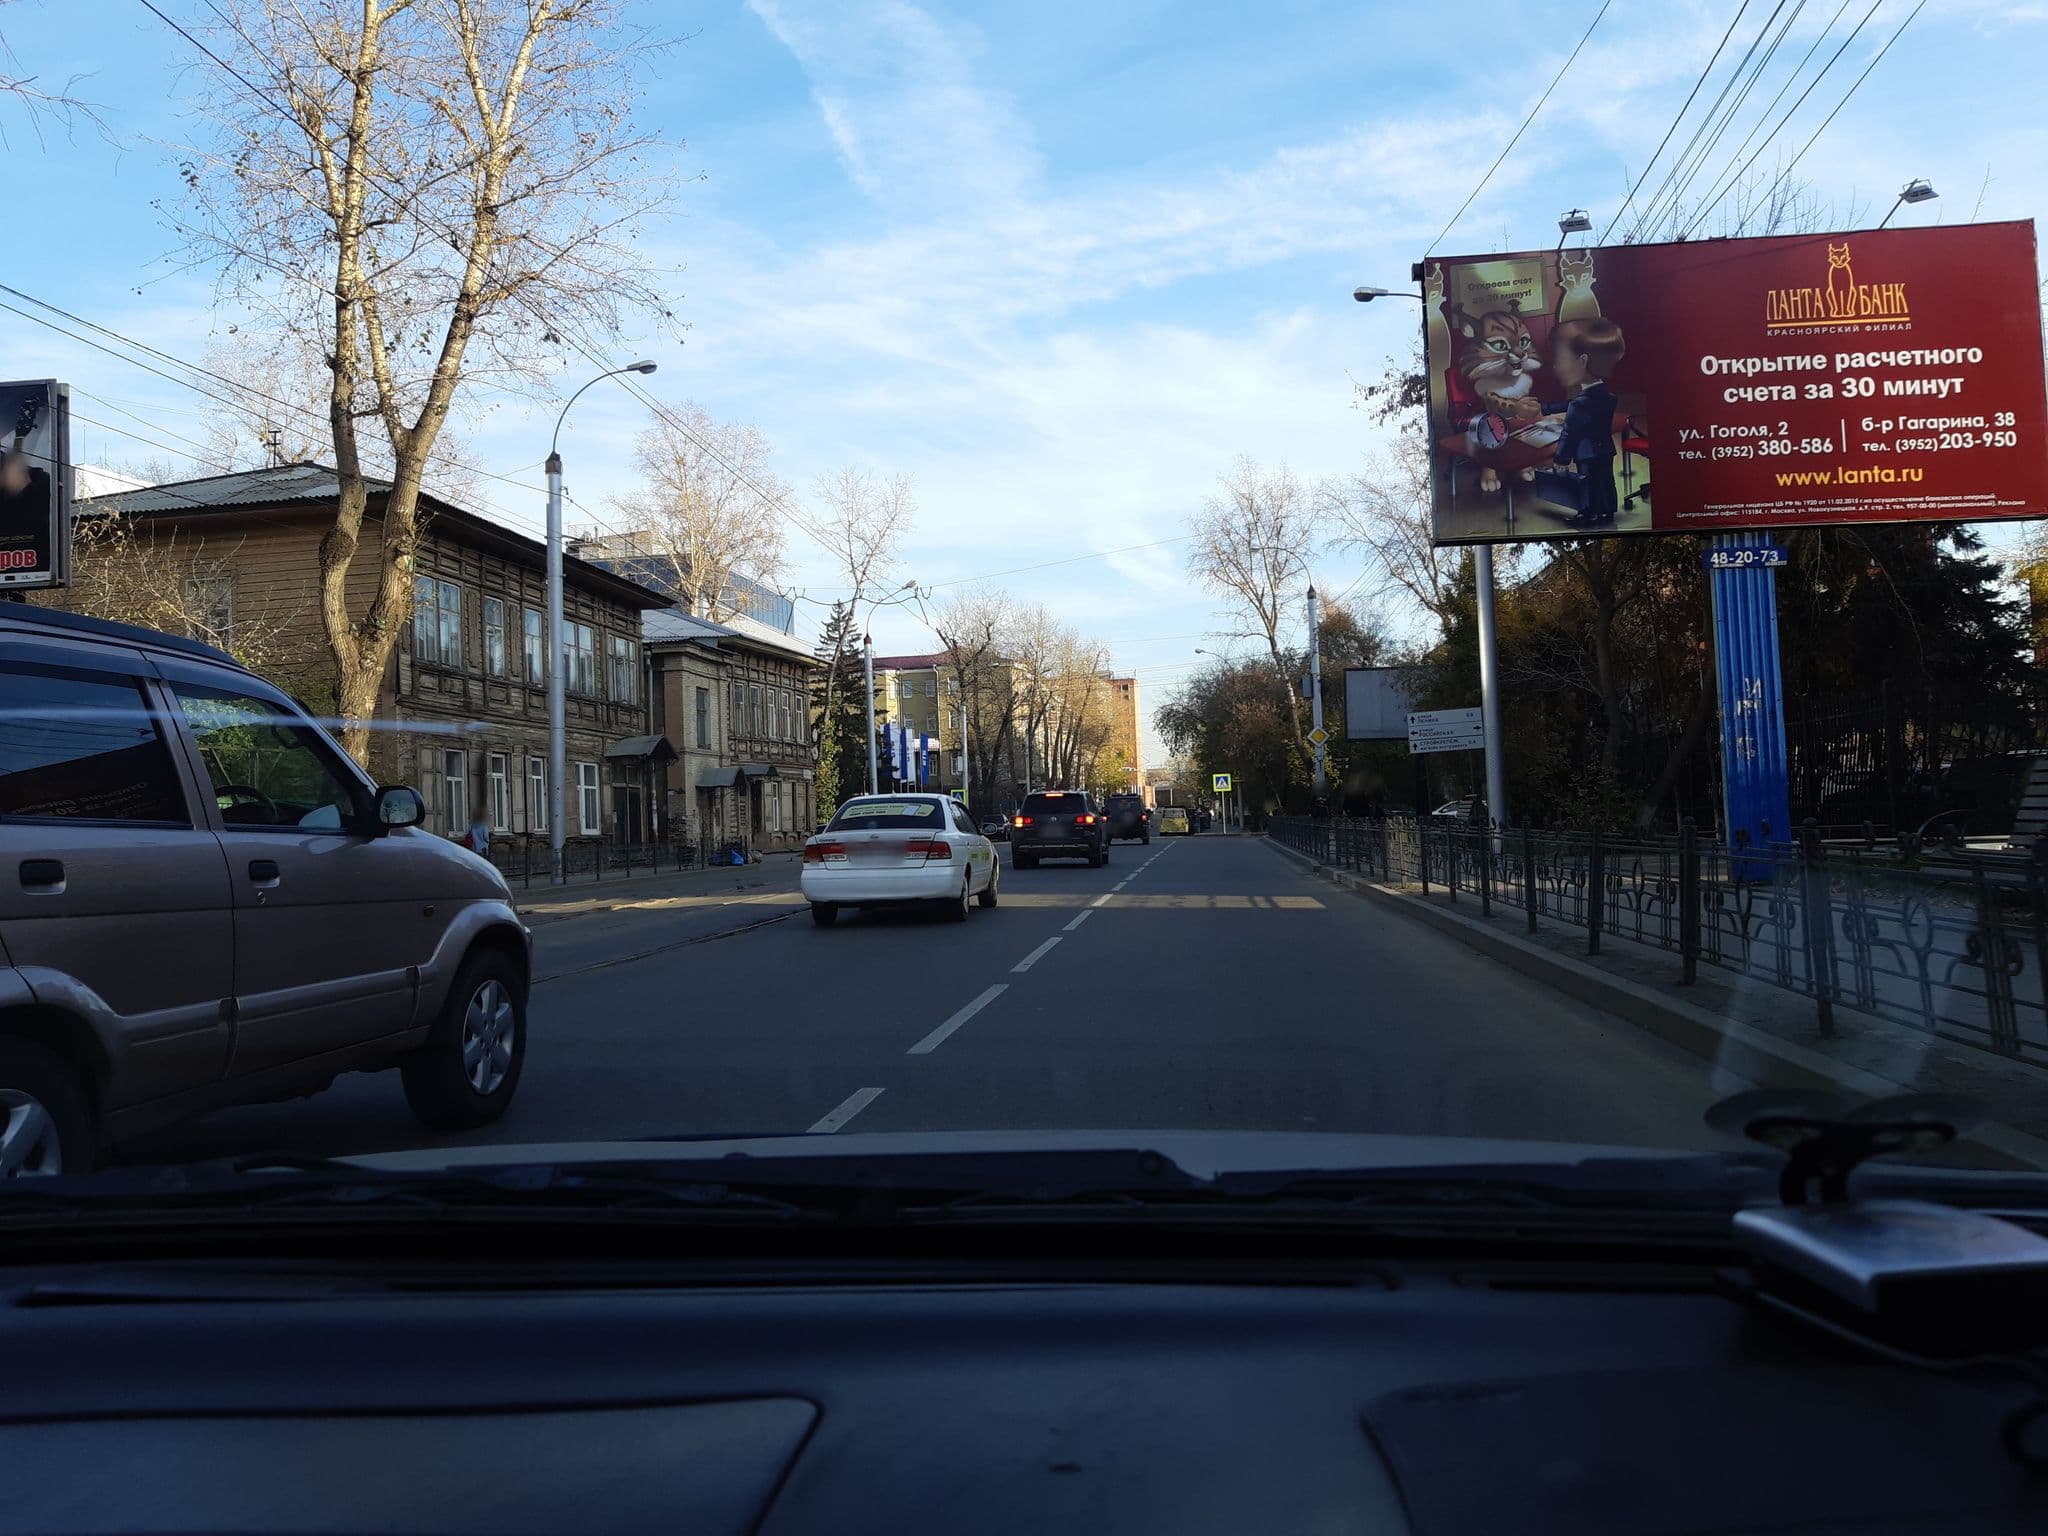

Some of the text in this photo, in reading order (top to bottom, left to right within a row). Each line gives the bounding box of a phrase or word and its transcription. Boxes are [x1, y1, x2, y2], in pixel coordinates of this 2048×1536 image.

[1766, 283, 1908, 320] ЛАНТА БАНК
[1767, 323, 1912, 337] КРАСНОЯРСКИЙ ФИЛИАЛ
[1700, 347, 1983, 377] Открытие расчетного
[1723, 376, 1964, 403] счета за 30 минут
[1679, 421, 1789, 443] ул. Гоголя, 2
[1861, 412, 2016, 434] б-р Гагарина, 38
[1678, 438, 1833, 460] тел. (3952) 380-586
[1862, 431, 2017, 453] тел. (3952) 203-950
[1776, 465, 1923, 487] www.lanta.ru
[1710, 550, 1779, 564] 48-20-73
